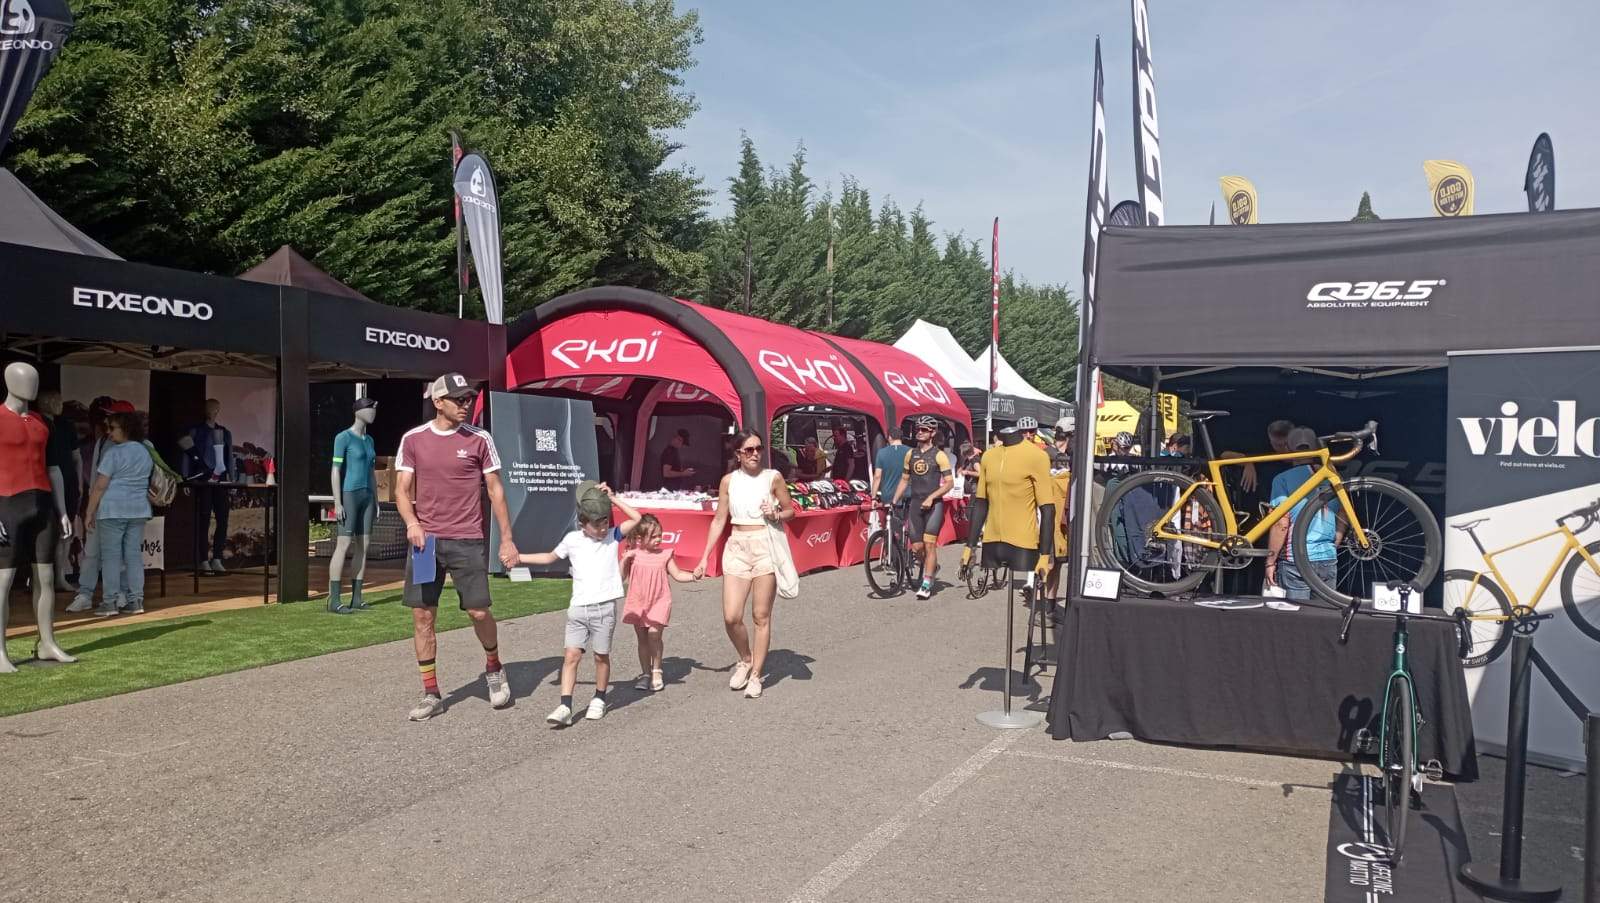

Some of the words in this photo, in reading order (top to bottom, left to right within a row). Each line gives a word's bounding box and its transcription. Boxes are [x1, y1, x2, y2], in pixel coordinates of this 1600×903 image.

[0, 39, 53, 50] EONDO
[73, 286, 213, 320] ETXEONDO
[1371, 300, 1430, 308] EQUIPMENT
[365, 327, 450, 352] ETXEONDO
[1097, 414, 1133, 422] VIC
[1349, 860, 1370, 886] MATTIO
